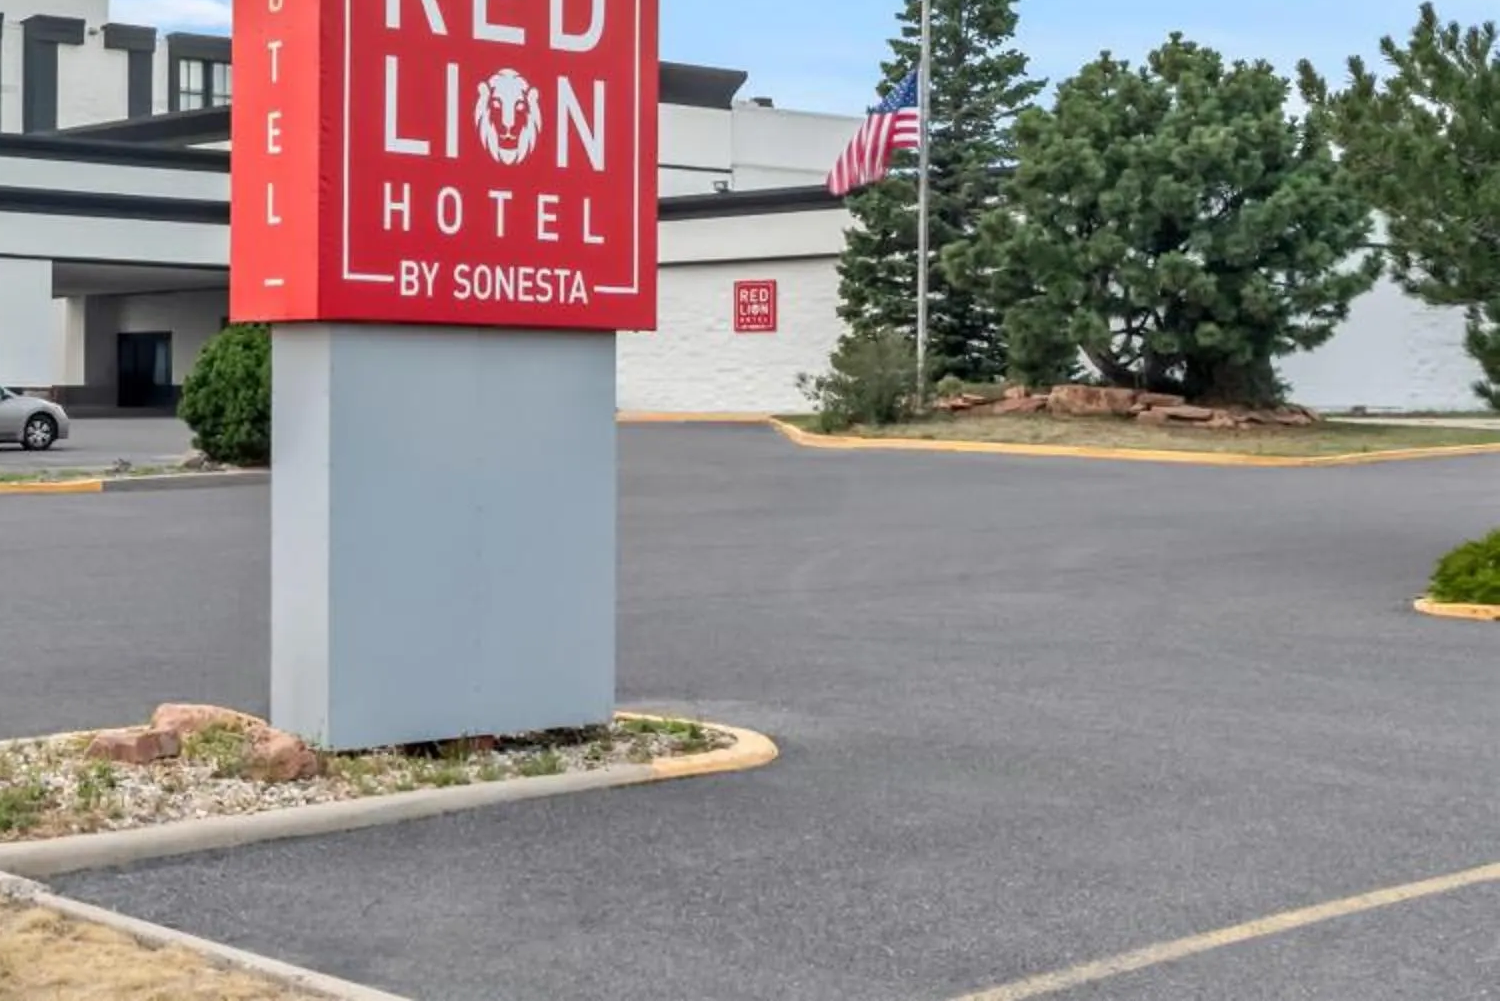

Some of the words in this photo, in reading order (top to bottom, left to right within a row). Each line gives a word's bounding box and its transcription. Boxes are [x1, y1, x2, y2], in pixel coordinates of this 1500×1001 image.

[384, 55, 605, 172] LION
[382, 182, 605, 245] HOTEL
[399, 260, 439, 298] BY
[452, 262, 589, 305] SONESTA
[740, 288, 769, 302] RED
